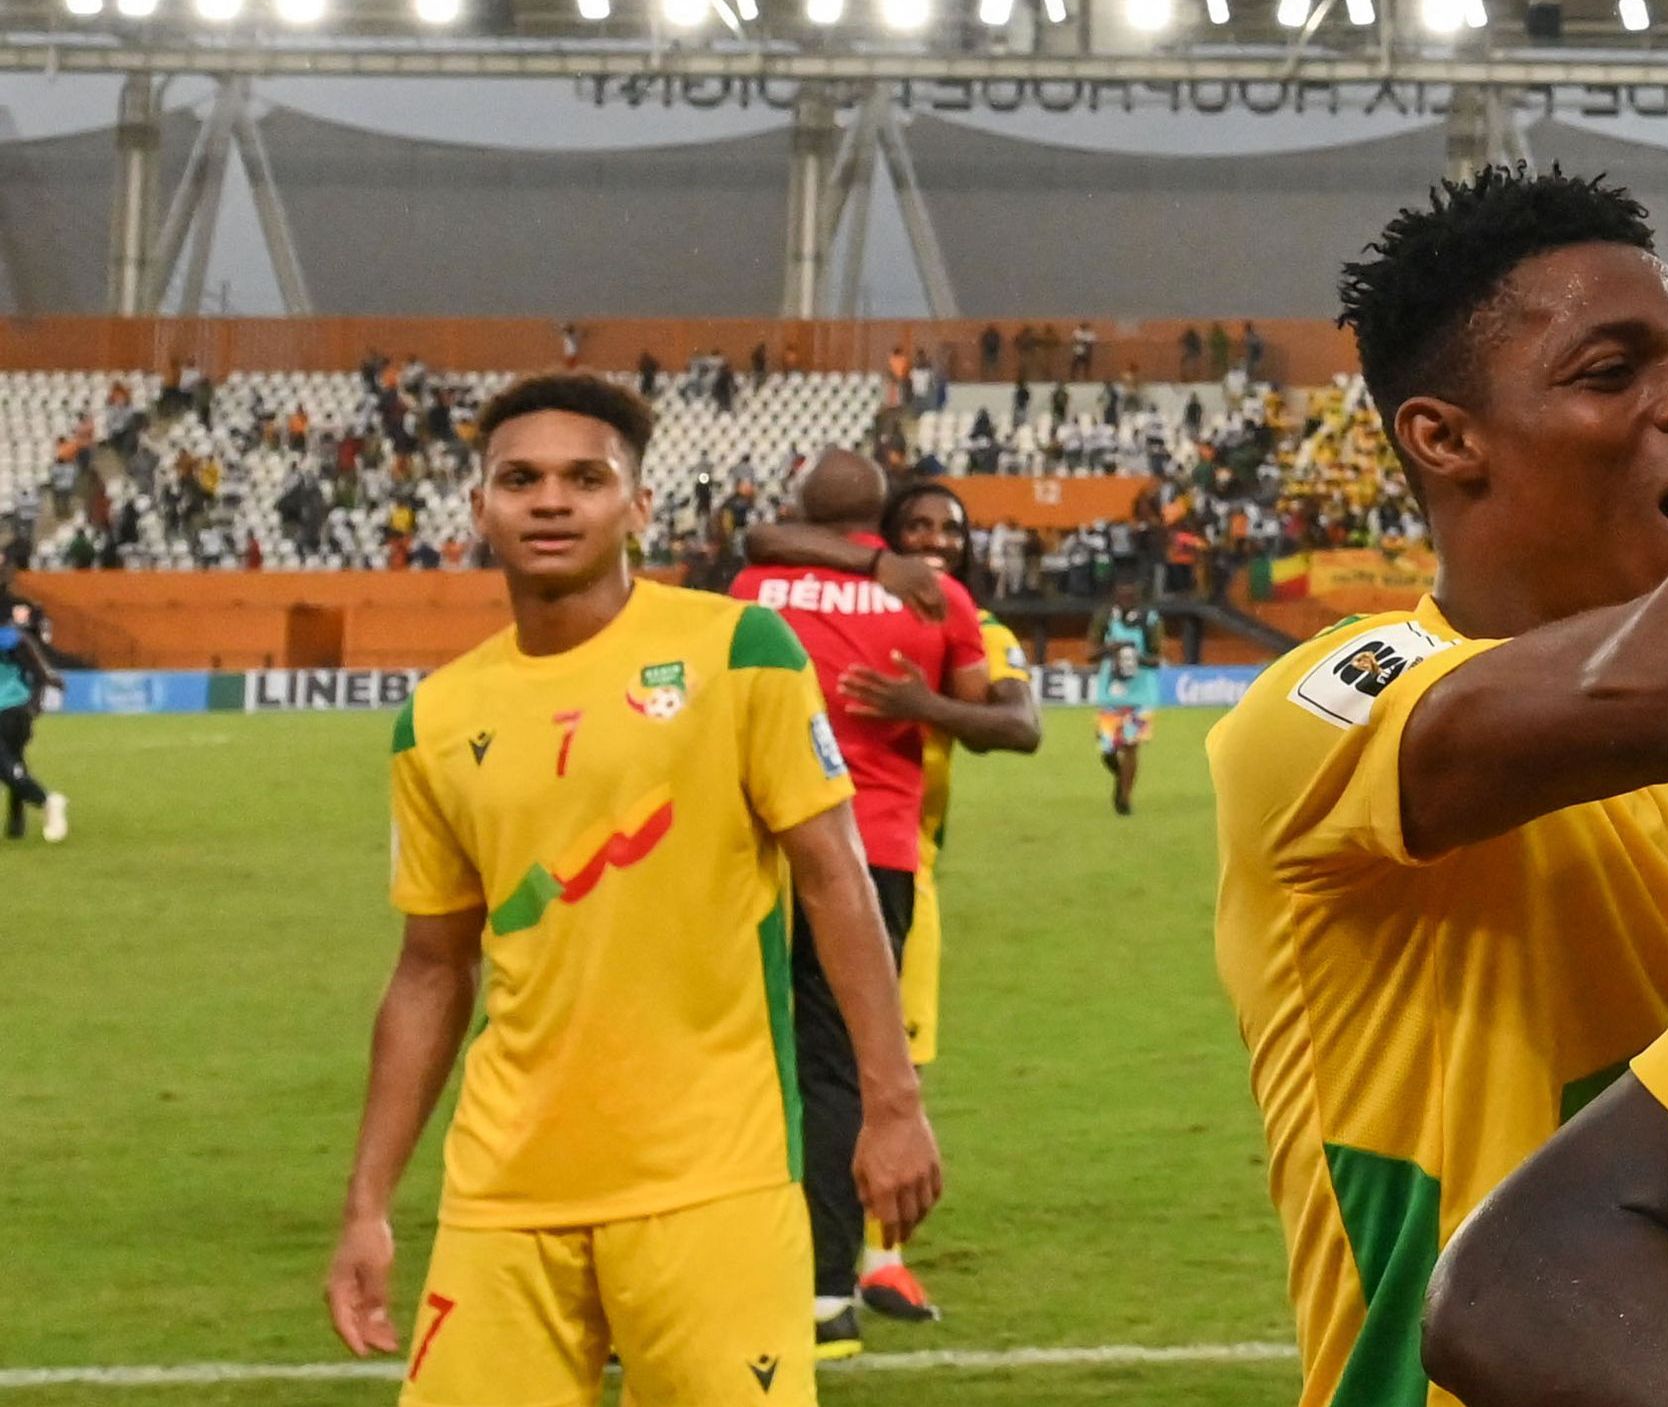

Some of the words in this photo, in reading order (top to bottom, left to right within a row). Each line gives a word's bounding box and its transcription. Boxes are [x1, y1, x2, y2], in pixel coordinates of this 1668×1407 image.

[257, 672, 424, 709] LINEB
[553, 710, 582, 778] 7
[409, 1293, 456, 1383] 7
